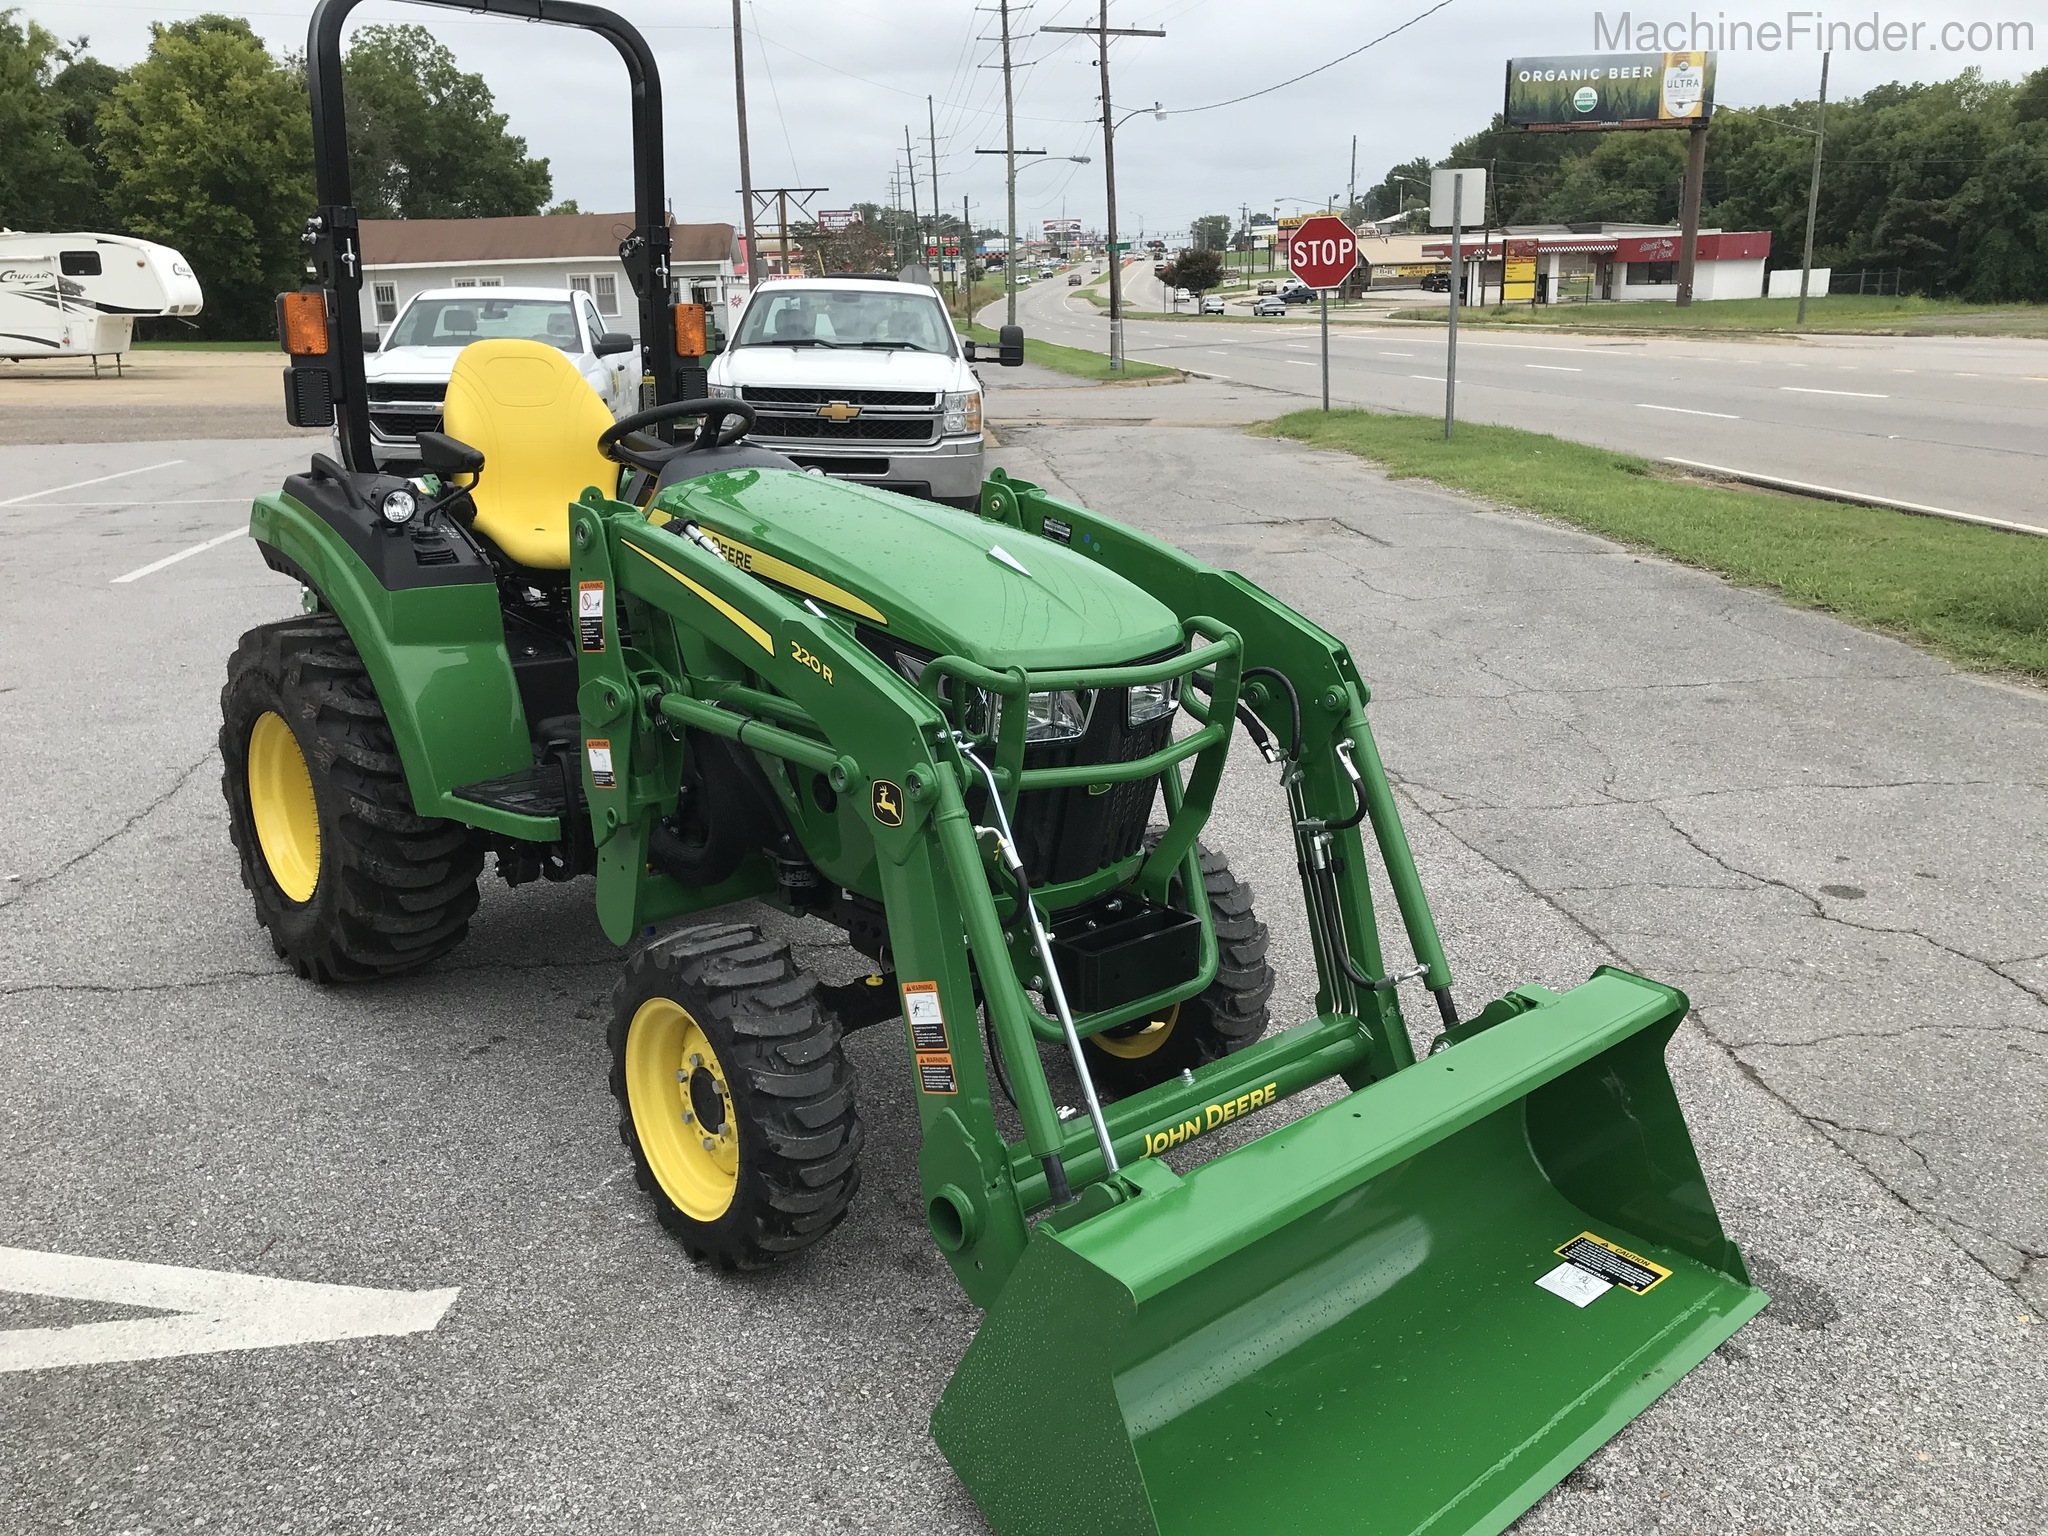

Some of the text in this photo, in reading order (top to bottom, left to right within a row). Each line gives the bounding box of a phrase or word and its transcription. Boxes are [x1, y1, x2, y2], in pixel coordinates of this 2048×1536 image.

[1519, 66, 1653, 83] ORGANIC BEER
[1666, 79, 1699, 88] ULTRA
[1294, 239, 1354, 267] STOP
[1139, 1082, 1277, 1160] JOHN DEERE
[1615, 1248, 1651, 1267] CAUTION
[1574, 1262, 1611, 1281] IMPORTANT
